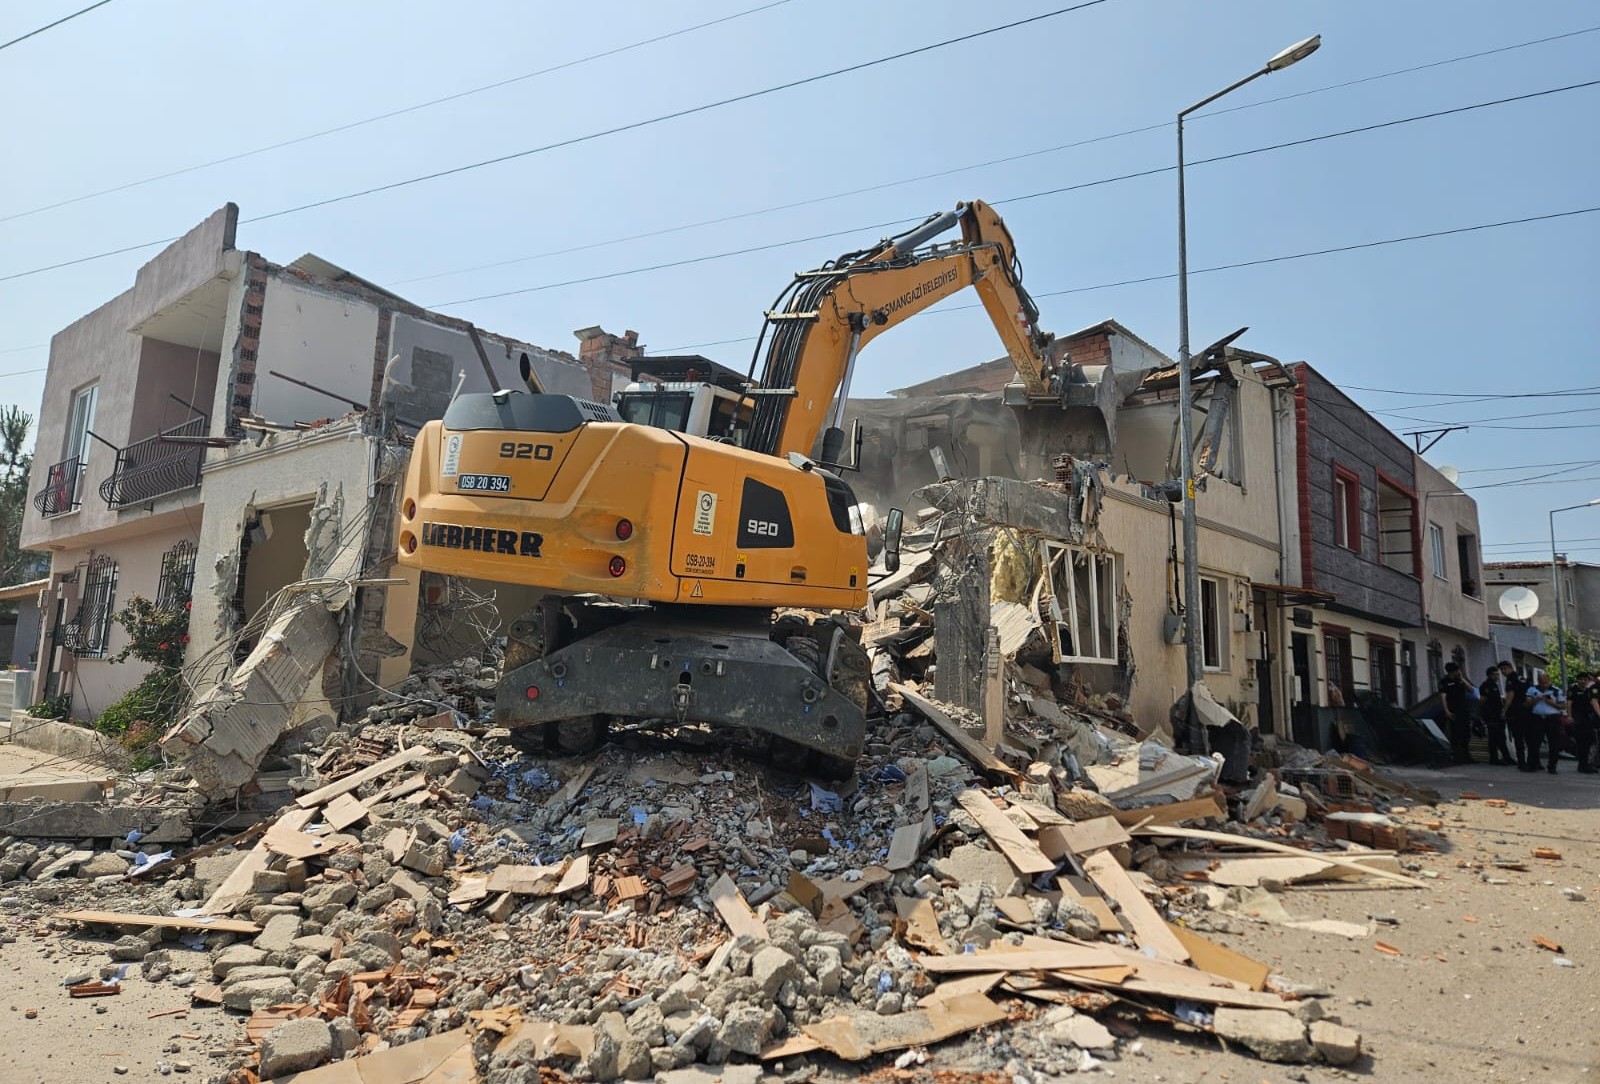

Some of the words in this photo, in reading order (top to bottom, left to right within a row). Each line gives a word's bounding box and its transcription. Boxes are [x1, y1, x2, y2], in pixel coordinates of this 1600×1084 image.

[499, 442, 554, 461] 920
[461, 475, 475, 488] OSB
[476, 476, 488, 490] 20
[490, 477, 508, 491] 394
[747, 519, 779, 537] 920
[422, 522, 543, 557] LIEBHERR
